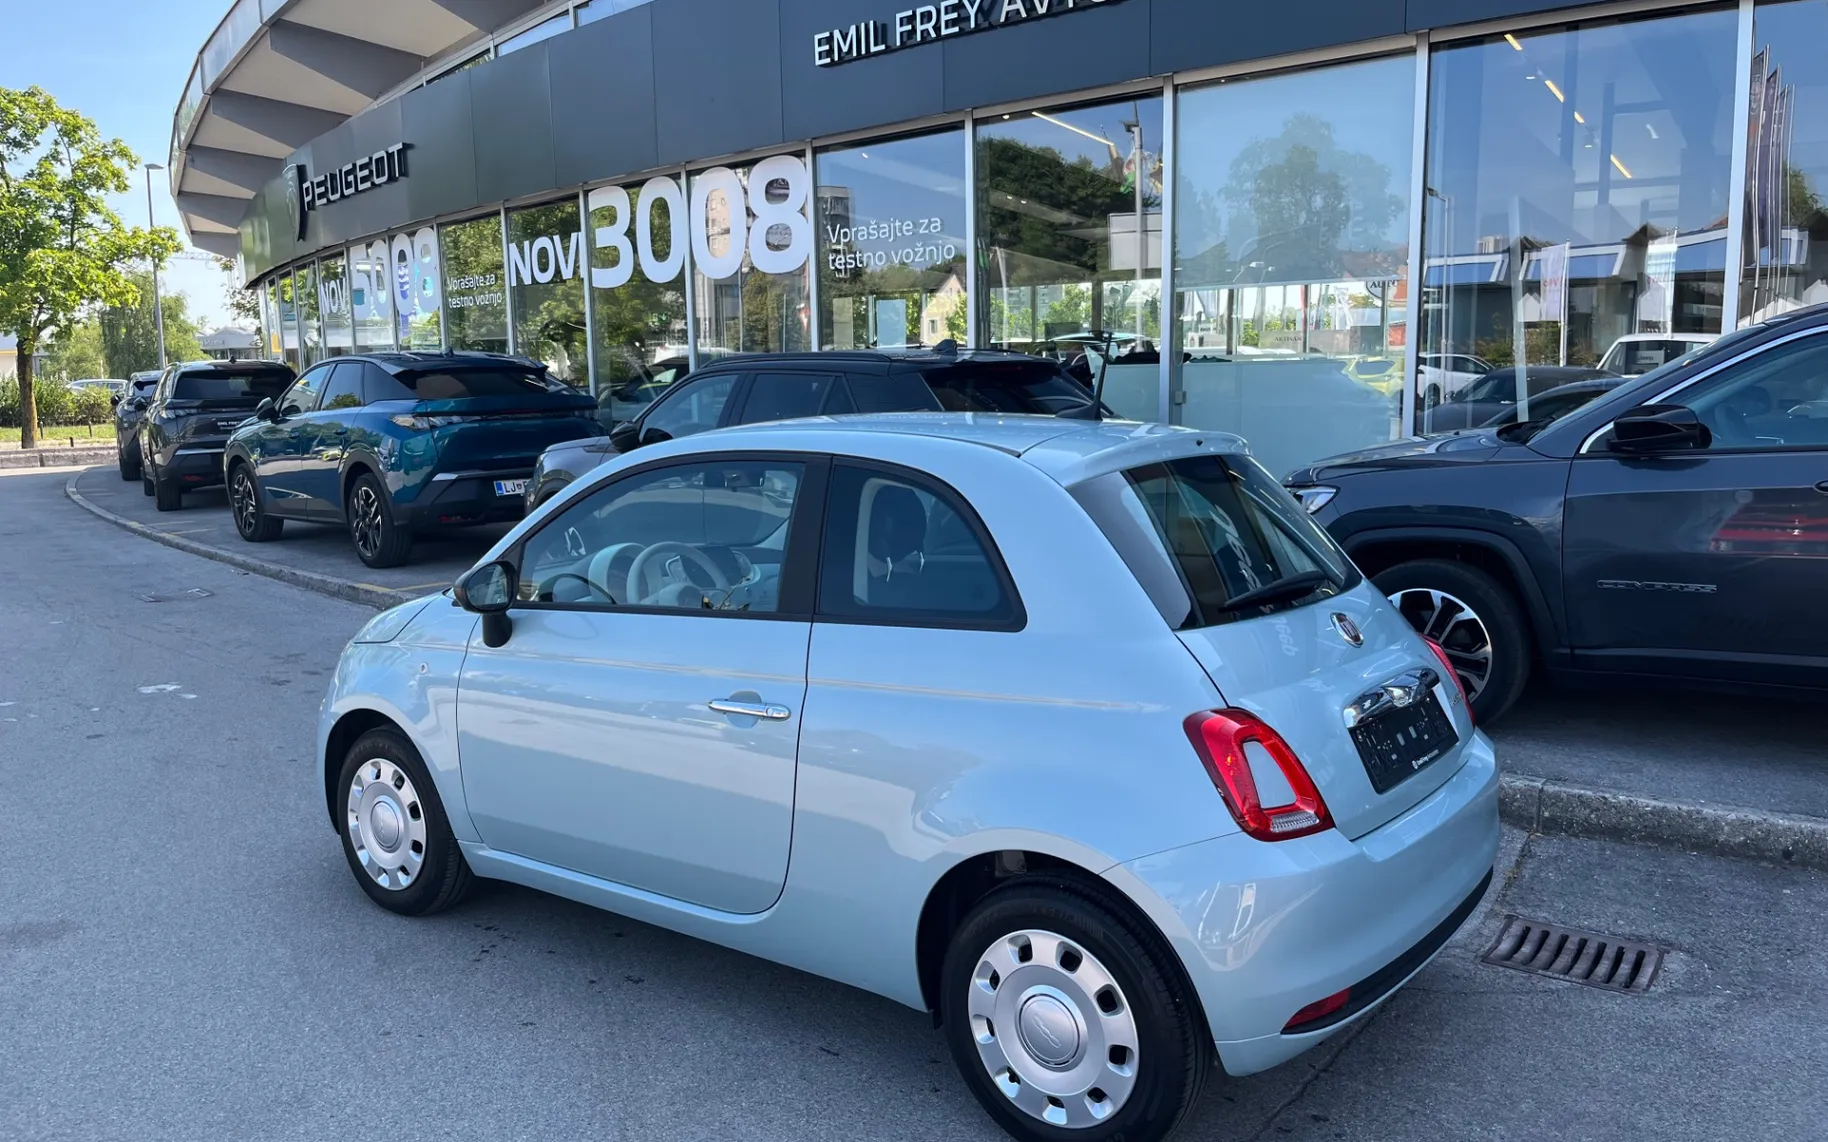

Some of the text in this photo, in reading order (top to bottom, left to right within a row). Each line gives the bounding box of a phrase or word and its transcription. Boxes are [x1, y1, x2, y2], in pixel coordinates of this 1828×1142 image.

[814, 20, 886, 66] EMIL
[895, 0, 980, 46] FREY
[302, 142, 404, 211] PEUGEOT
[588, 155, 810, 290] 3008
[826, 217, 941, 247] Vprašajte za
[828, 240, 955, 270] testno vožnjo
[485, 273, 496, 286] za
[320, 278, 347, 315] NOV
[448, 291, 502, 308] testno vožnjo
